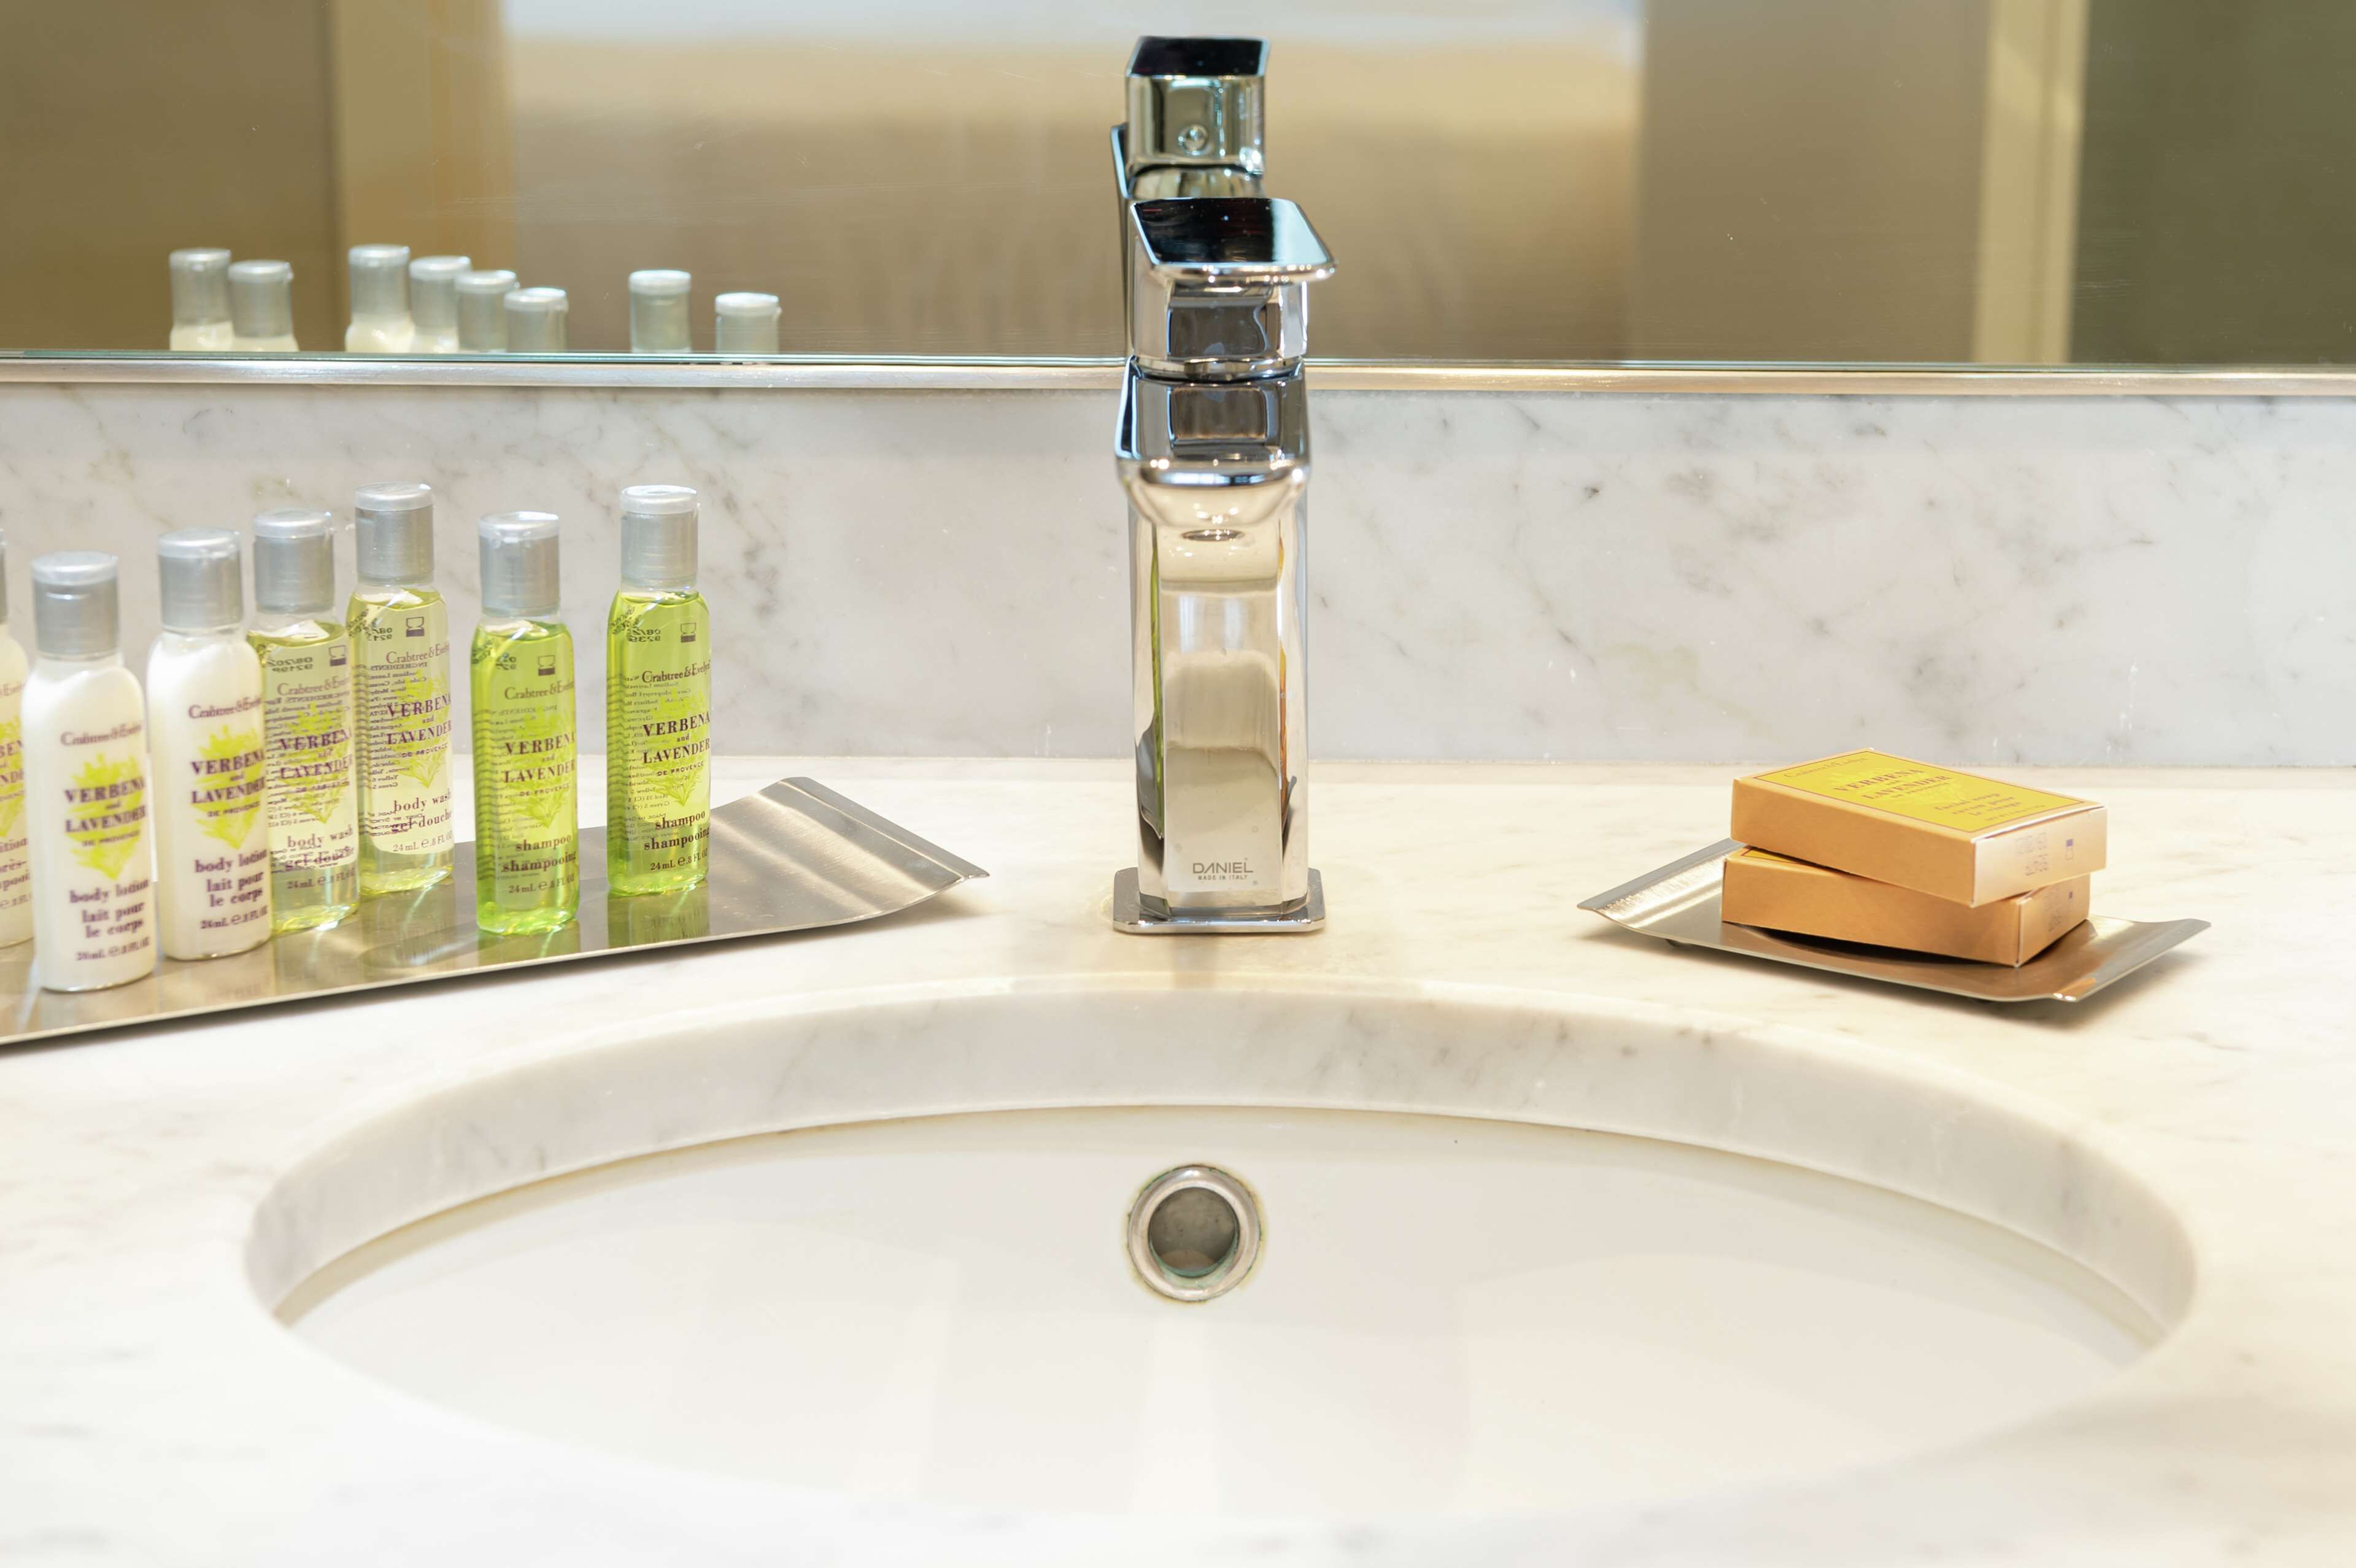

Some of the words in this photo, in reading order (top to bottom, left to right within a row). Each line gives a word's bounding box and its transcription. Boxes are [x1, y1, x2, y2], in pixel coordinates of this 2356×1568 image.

[422, 715, 434, 724] and
[643, 711, 711, 736] VERBENA
[677, 733, 690, 742] and
[541, 753, 555, 762] and
[643, 738, 710, 763] LAVENDER
[671, 760, 704, 773] PROVENCE
[1833, 769, 1925, 791] VERBENA
[1862, 775, 1952, 800] LAVENDER
[394, 797, 427, 811] body
[655, 811, 706, 830] shampoo
[287, 833, 324, 848] body
[516, 835, 571, 852] shampoo
[644, 827, 710, 850] shampooing
[195, 857, 233, 873] body
[239, 849, 268, 867] lotion
[501, 851, 576, 873] shampooing
[1192, 862, 1254, 874] DANIEL
[69, 887, 109, 903] body
[116, 879, 149, 897] lotion
[206, 878, 232, 892] lait
[238, 871, 264, 891] pour
[209, 894, 224, 907] le
[230, 887, 263, 904] corps
[82, 909, 109, 923] lait
[115, 902, 145, 921] pour
[86, 925, 100, 938] le
[107, 918, 144, 933] corps
